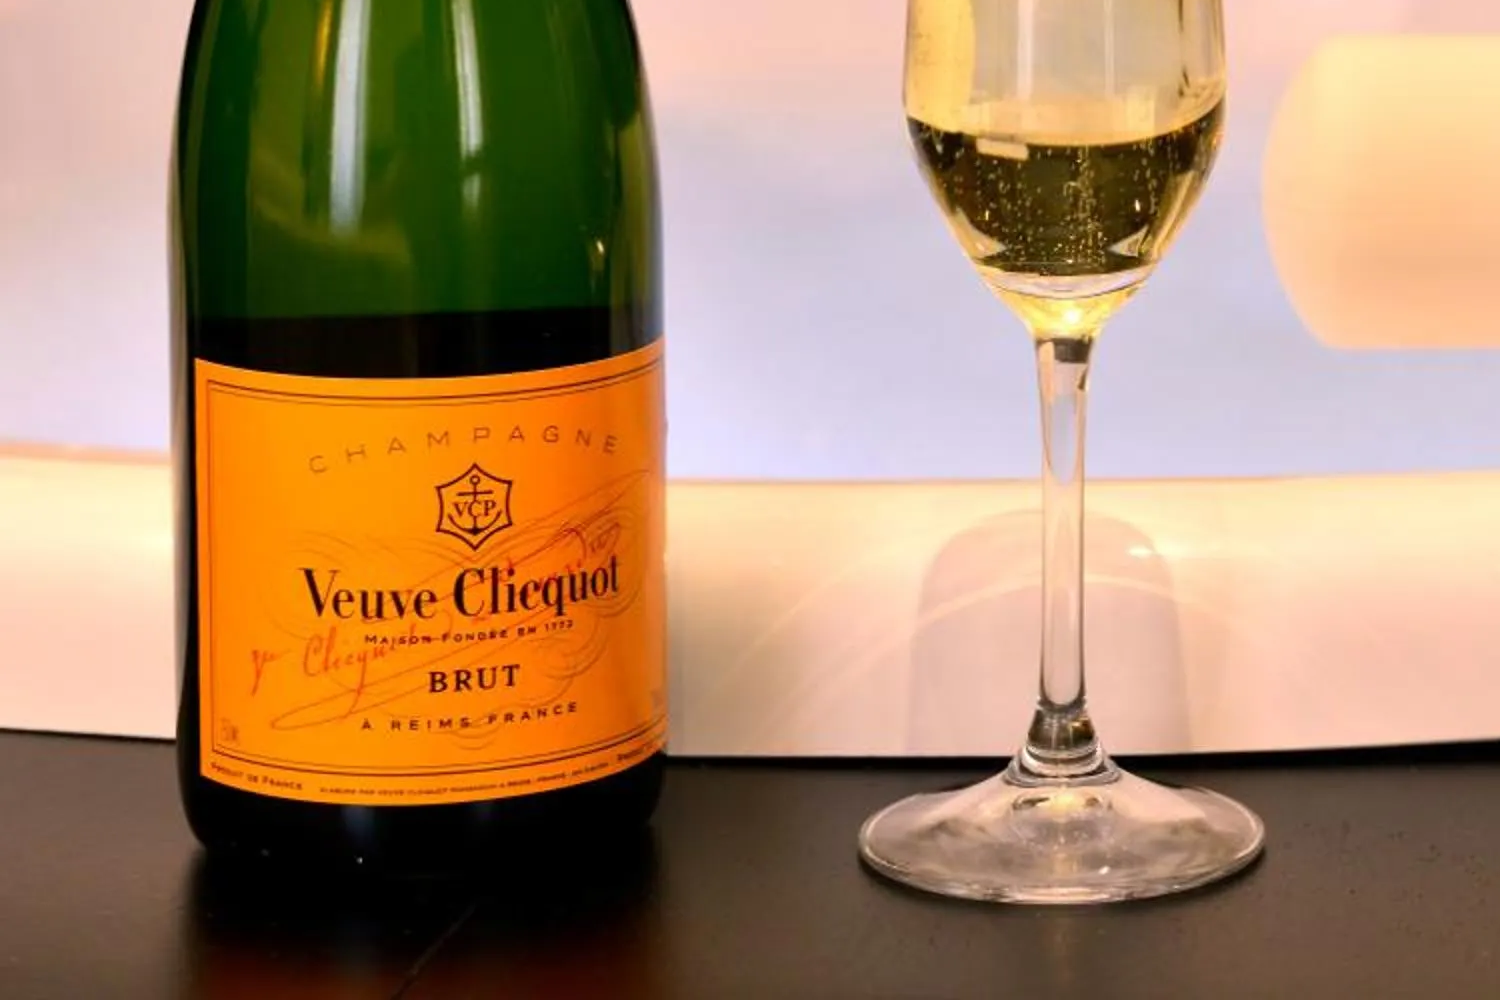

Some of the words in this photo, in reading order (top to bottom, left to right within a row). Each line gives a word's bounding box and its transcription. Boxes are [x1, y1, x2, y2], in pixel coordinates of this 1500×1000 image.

[308, 425, 619, 474] CHAMPAGNE
[453, 500, 497, 518] VCP
[299, 567, 438, 620] Veuve
[453, 555, 620, 618] Clicquot
[364, 633, 432, 646] MAISON
[429, 664, 521, 693] BRUT
[391, 718, 472, 731] REIMS
[487, 701, 577, 725] FRANCE
